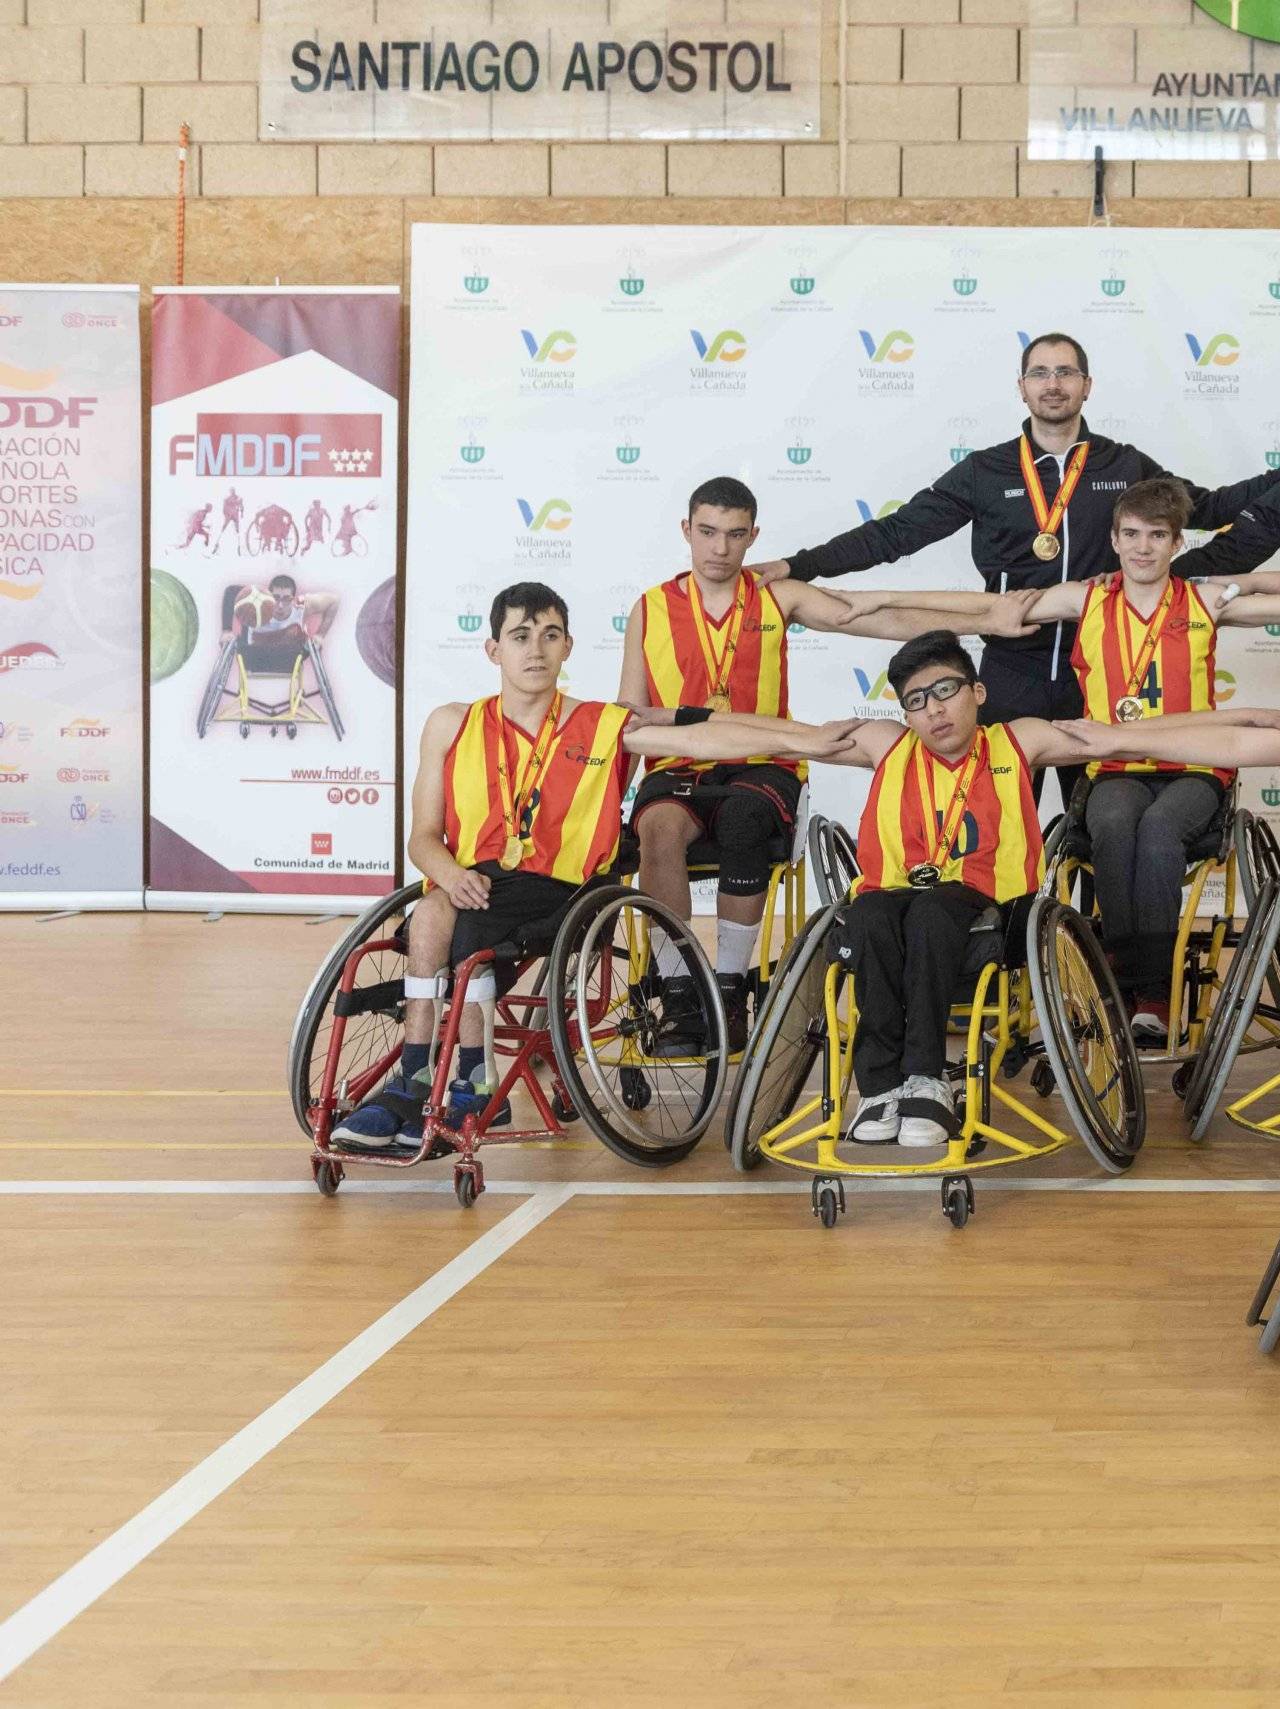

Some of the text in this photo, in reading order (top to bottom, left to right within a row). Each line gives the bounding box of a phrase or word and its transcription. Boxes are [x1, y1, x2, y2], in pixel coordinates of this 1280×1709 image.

[290, 40, 792, 93] SANTIAGO APOSTOL
[1060, 106, 1253, 132] VILLANUEVA
[520, 367, 576, 379] Villanueva
[690, 367, 746, 380] Villanueva
[858, 367, 914, 380] Villanueva
[1184, 370, 1240, 383] Villanueva
[0, 432, 81, 457] ACIÓN
[169, 433, 322, 477] FMDDF
[515, 535, 572, 547] Villanueva
[853, 704, 904, 717] Villanuev
[291, 765, 381, 781] www.fmddf.es
[989, 765, 1013, 776] CEDF
[254, 857, 390, 871] Comunidad de Madrid
